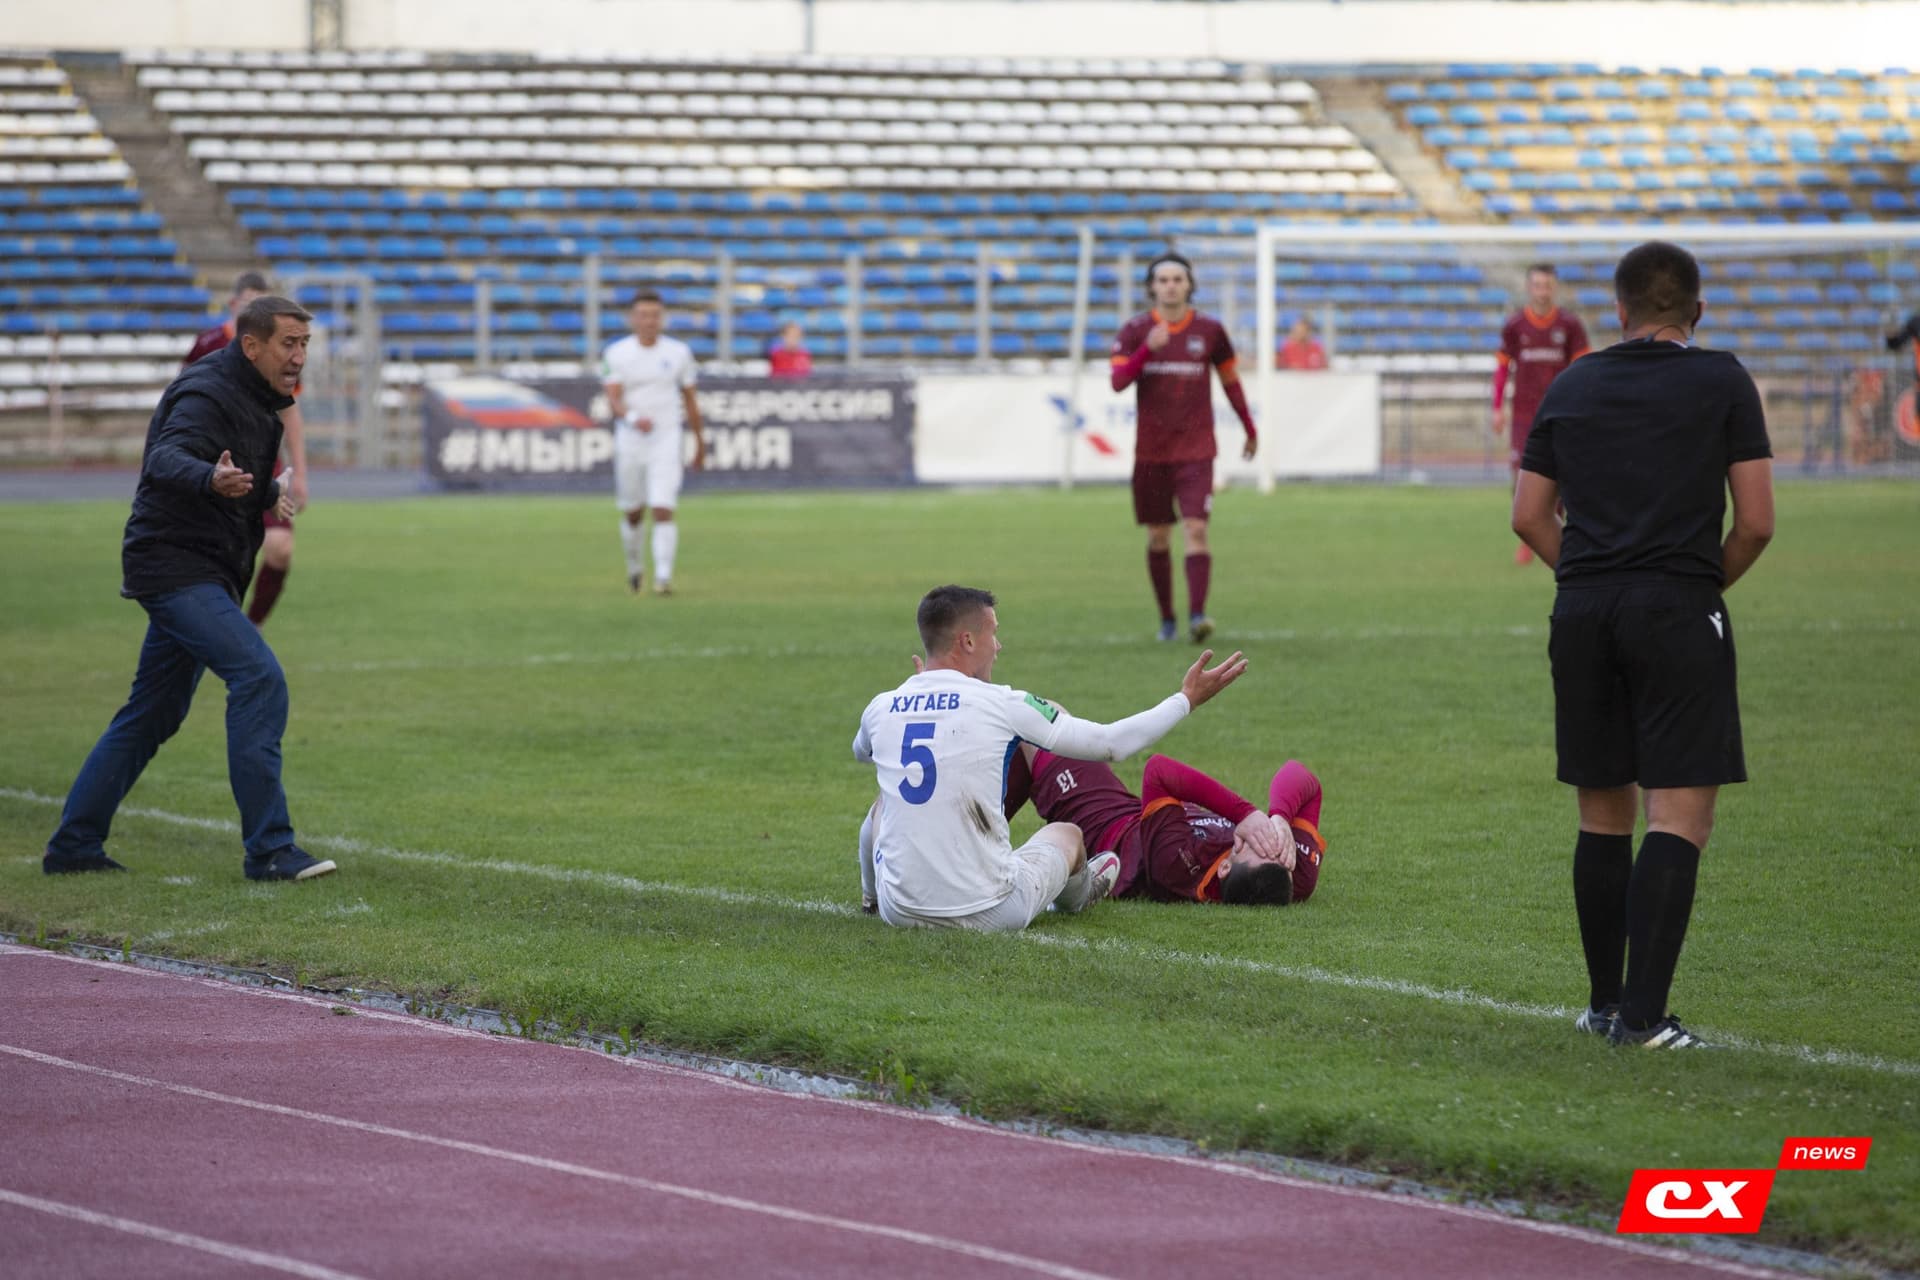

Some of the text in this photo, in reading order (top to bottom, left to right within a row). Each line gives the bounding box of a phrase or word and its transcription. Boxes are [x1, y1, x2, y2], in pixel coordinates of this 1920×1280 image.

[439, 427, 793, 472] #МЫРСИЯ
[889, 693, 961, 713] ХУГАЕВ
[898, 722, 937, 805] 5
[1056, 768, 1078, 794] 13
